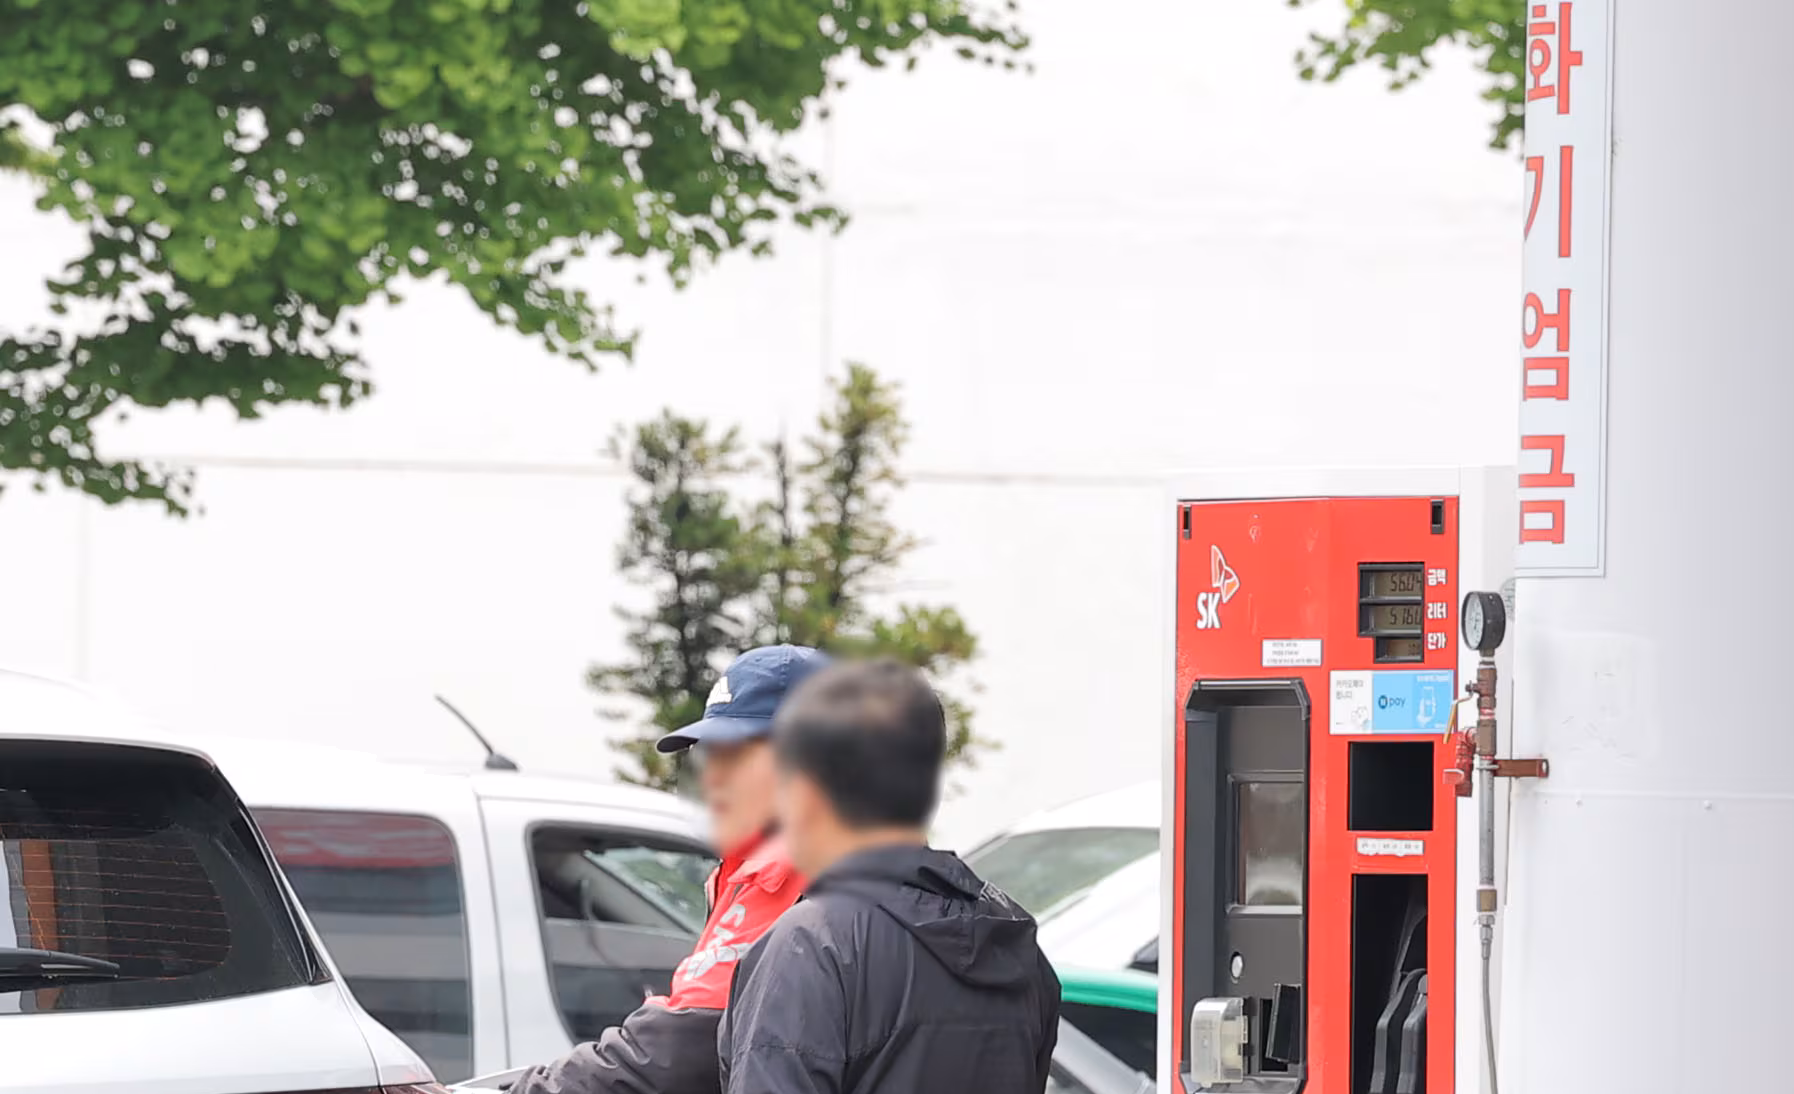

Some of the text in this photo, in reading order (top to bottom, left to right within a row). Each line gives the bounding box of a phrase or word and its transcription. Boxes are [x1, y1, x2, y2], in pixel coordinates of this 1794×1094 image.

[1518, 1, 1584, 545] 화기엄금
[1427, 568, 1447, 587] 금액
[1196, 592, 1221, 629] SK
[1427, 601, 1447, 620] 리터
[1427, 631, 1447, 650] 단가
